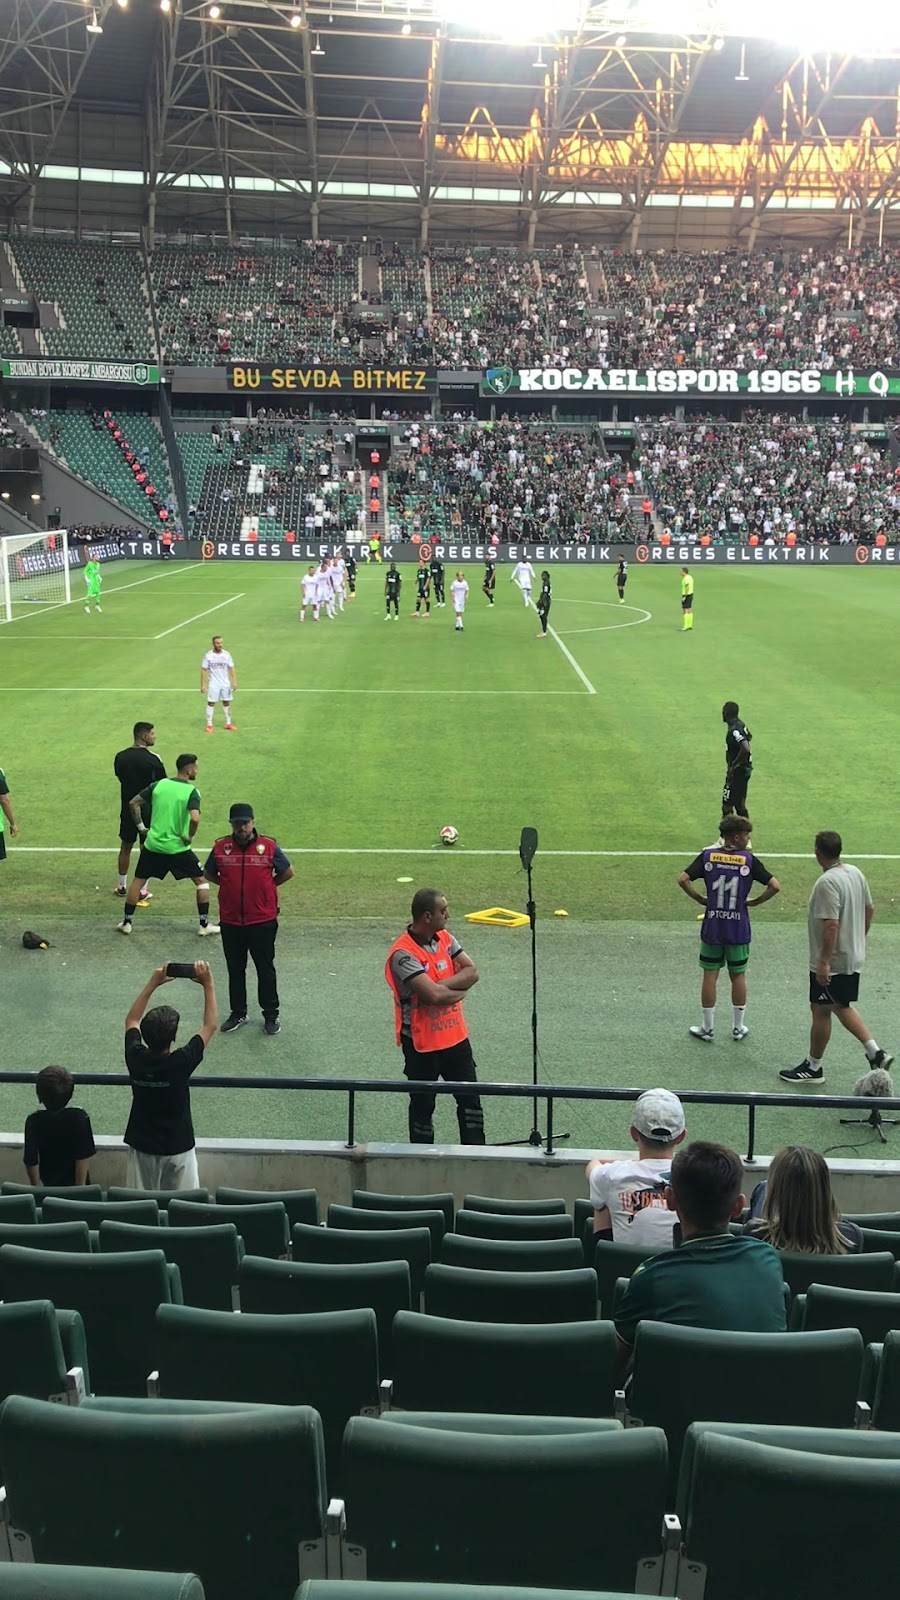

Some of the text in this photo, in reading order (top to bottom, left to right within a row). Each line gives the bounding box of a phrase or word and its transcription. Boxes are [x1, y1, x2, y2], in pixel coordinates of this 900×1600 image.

[233, 367, 427, 390] BU SEVDA BİTMEZ
[518, 368, 739, 392] KOCAELİSPOR
[747, 369, 821, 393] 1966
[218, 543, 394, 558] REGES ELEKTRK
[435, 544, 610, 559] REGES ELEKTRİK
[652, 545, 830, 560] REGES ELEKTRİK
[712, 875, 739, 910] 11
